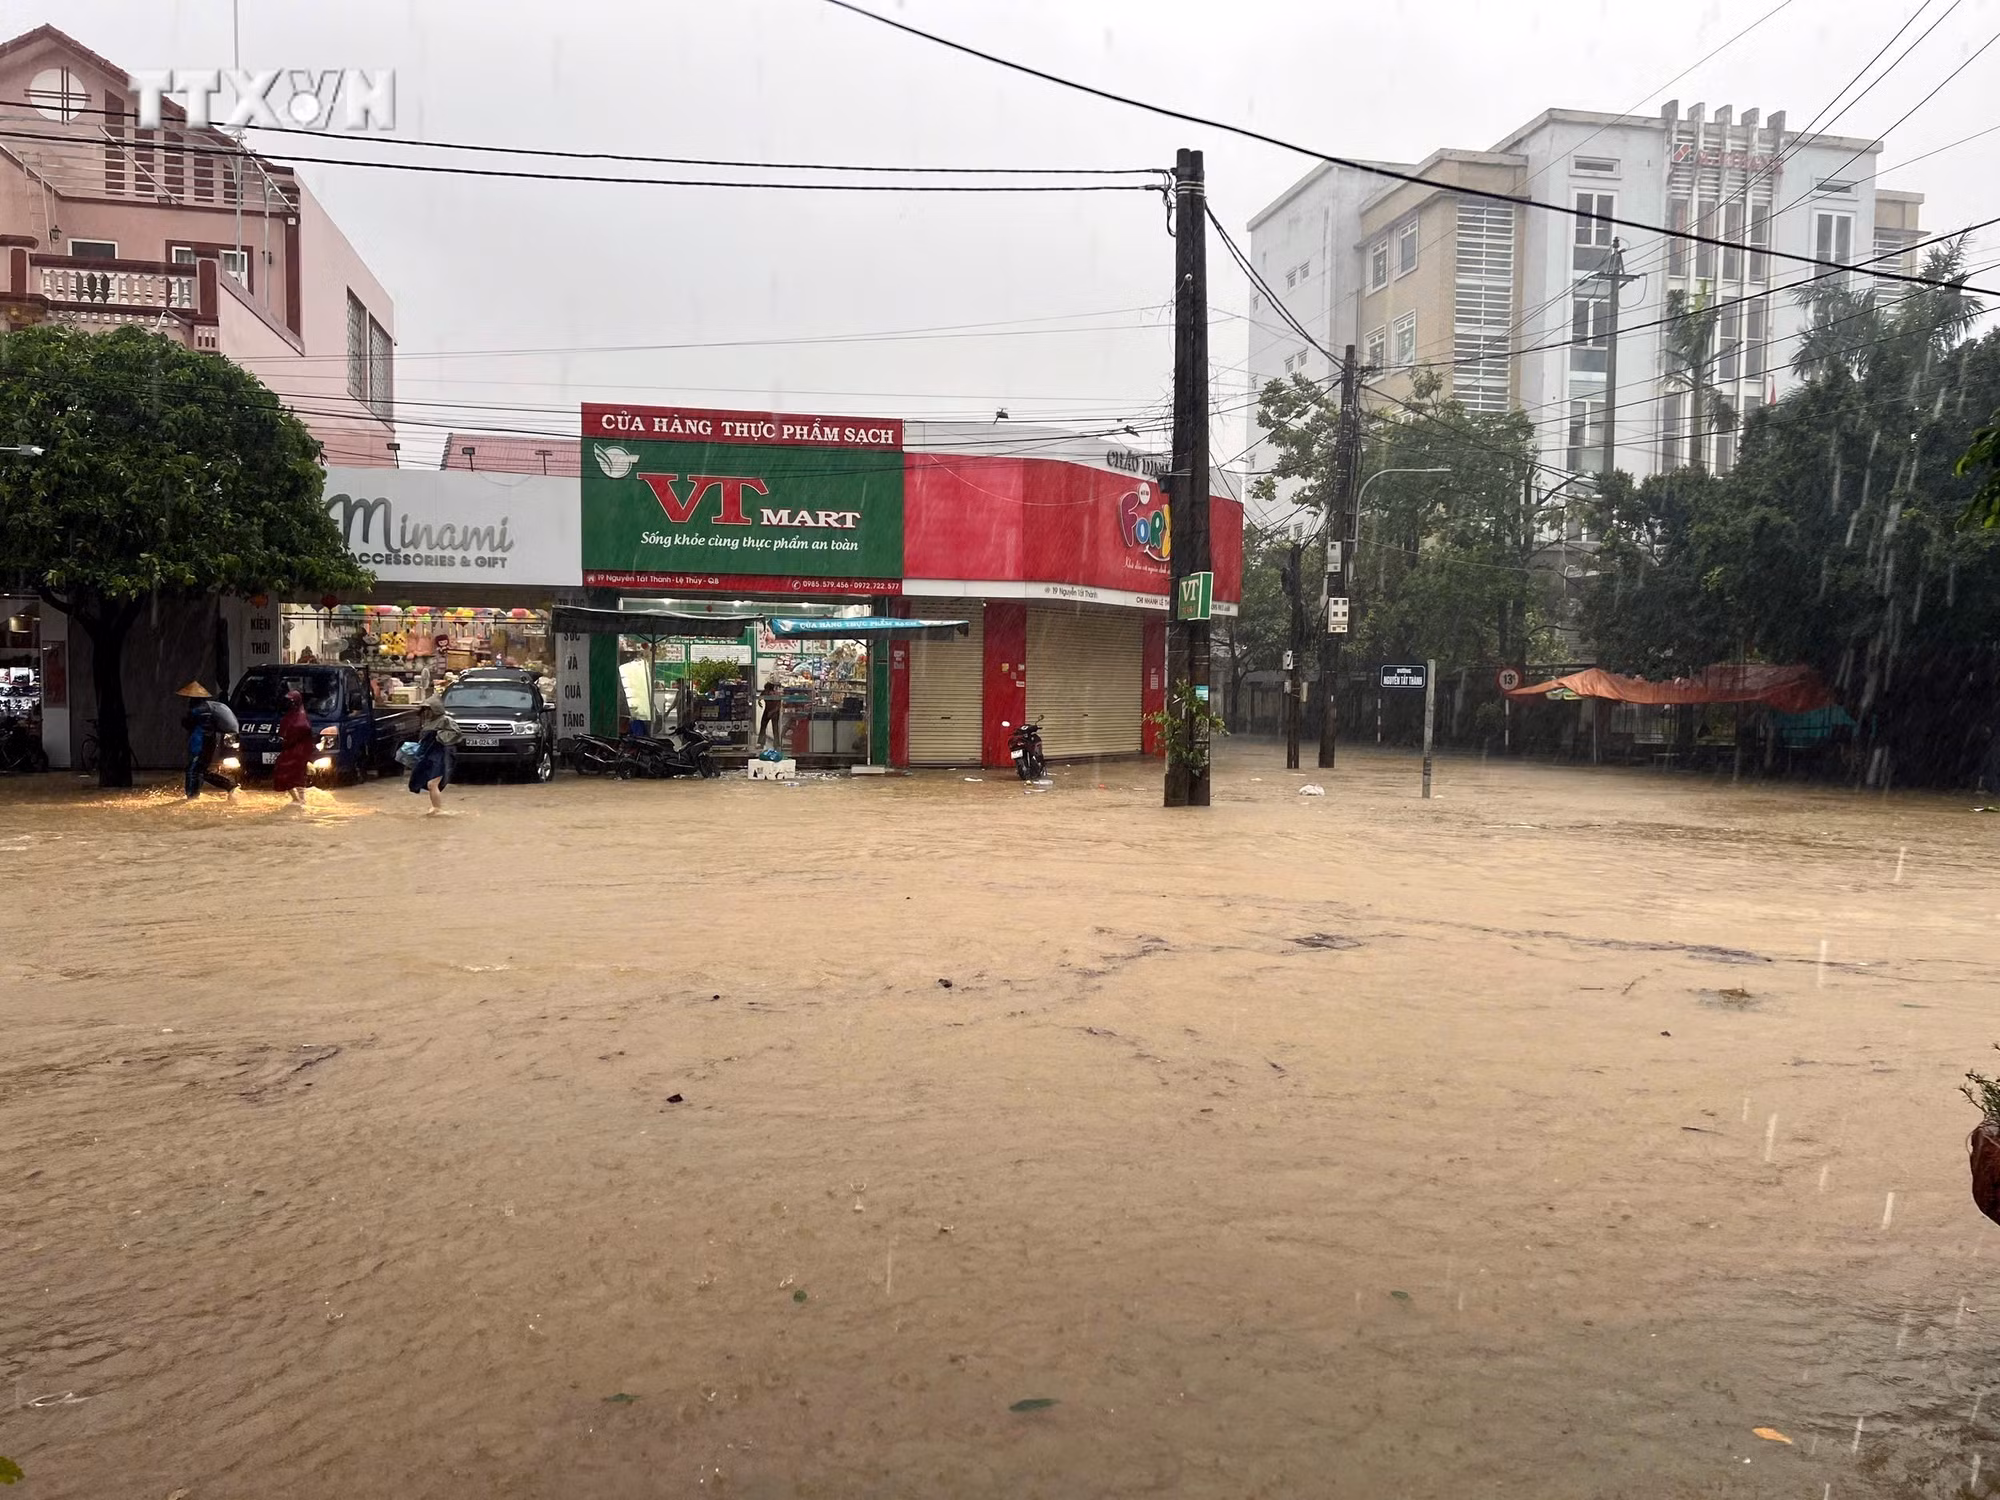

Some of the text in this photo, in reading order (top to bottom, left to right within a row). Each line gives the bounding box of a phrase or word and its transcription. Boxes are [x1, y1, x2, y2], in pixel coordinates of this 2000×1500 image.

[601, 410, 894, 446] CỬA HÀNG THỰC PHẨM SẠCH
[636, 472, 862, 529] VT MART
[325, 493, 515, 554] Minami
[640, 530, 859, 551] Sống khỏe cùng thực phẩm an toàn
[348, 552, 508, 569] ACCESSORIES & GIFT
[707, 577, 719, 585] QB
[802, 580, 849, 588] 0985.579.456
[1181, 579, 1199, 602] VT
[250, 615, 271, 634] KIỆN
[564, 681, 581, 699] QUÀ
[562, 710, 585, 731] TẶNG
